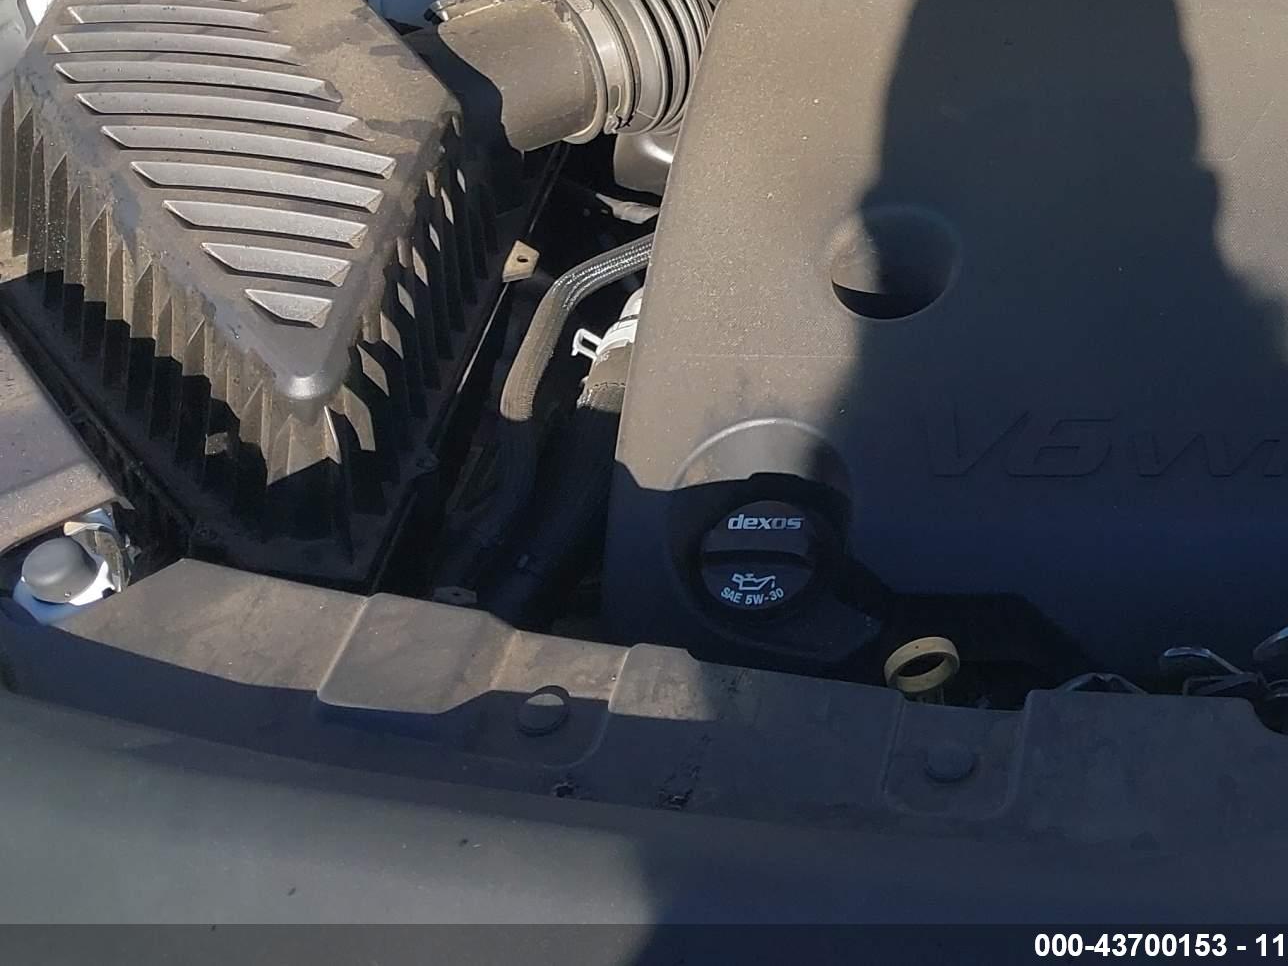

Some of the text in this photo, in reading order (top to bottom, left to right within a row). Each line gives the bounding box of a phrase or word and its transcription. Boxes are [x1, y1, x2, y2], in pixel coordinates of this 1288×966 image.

[923, 403, 1120, 479] V6
[728, 514, 803, 530] dexos
[721, 587, 784, 604] SAE 5W-30
